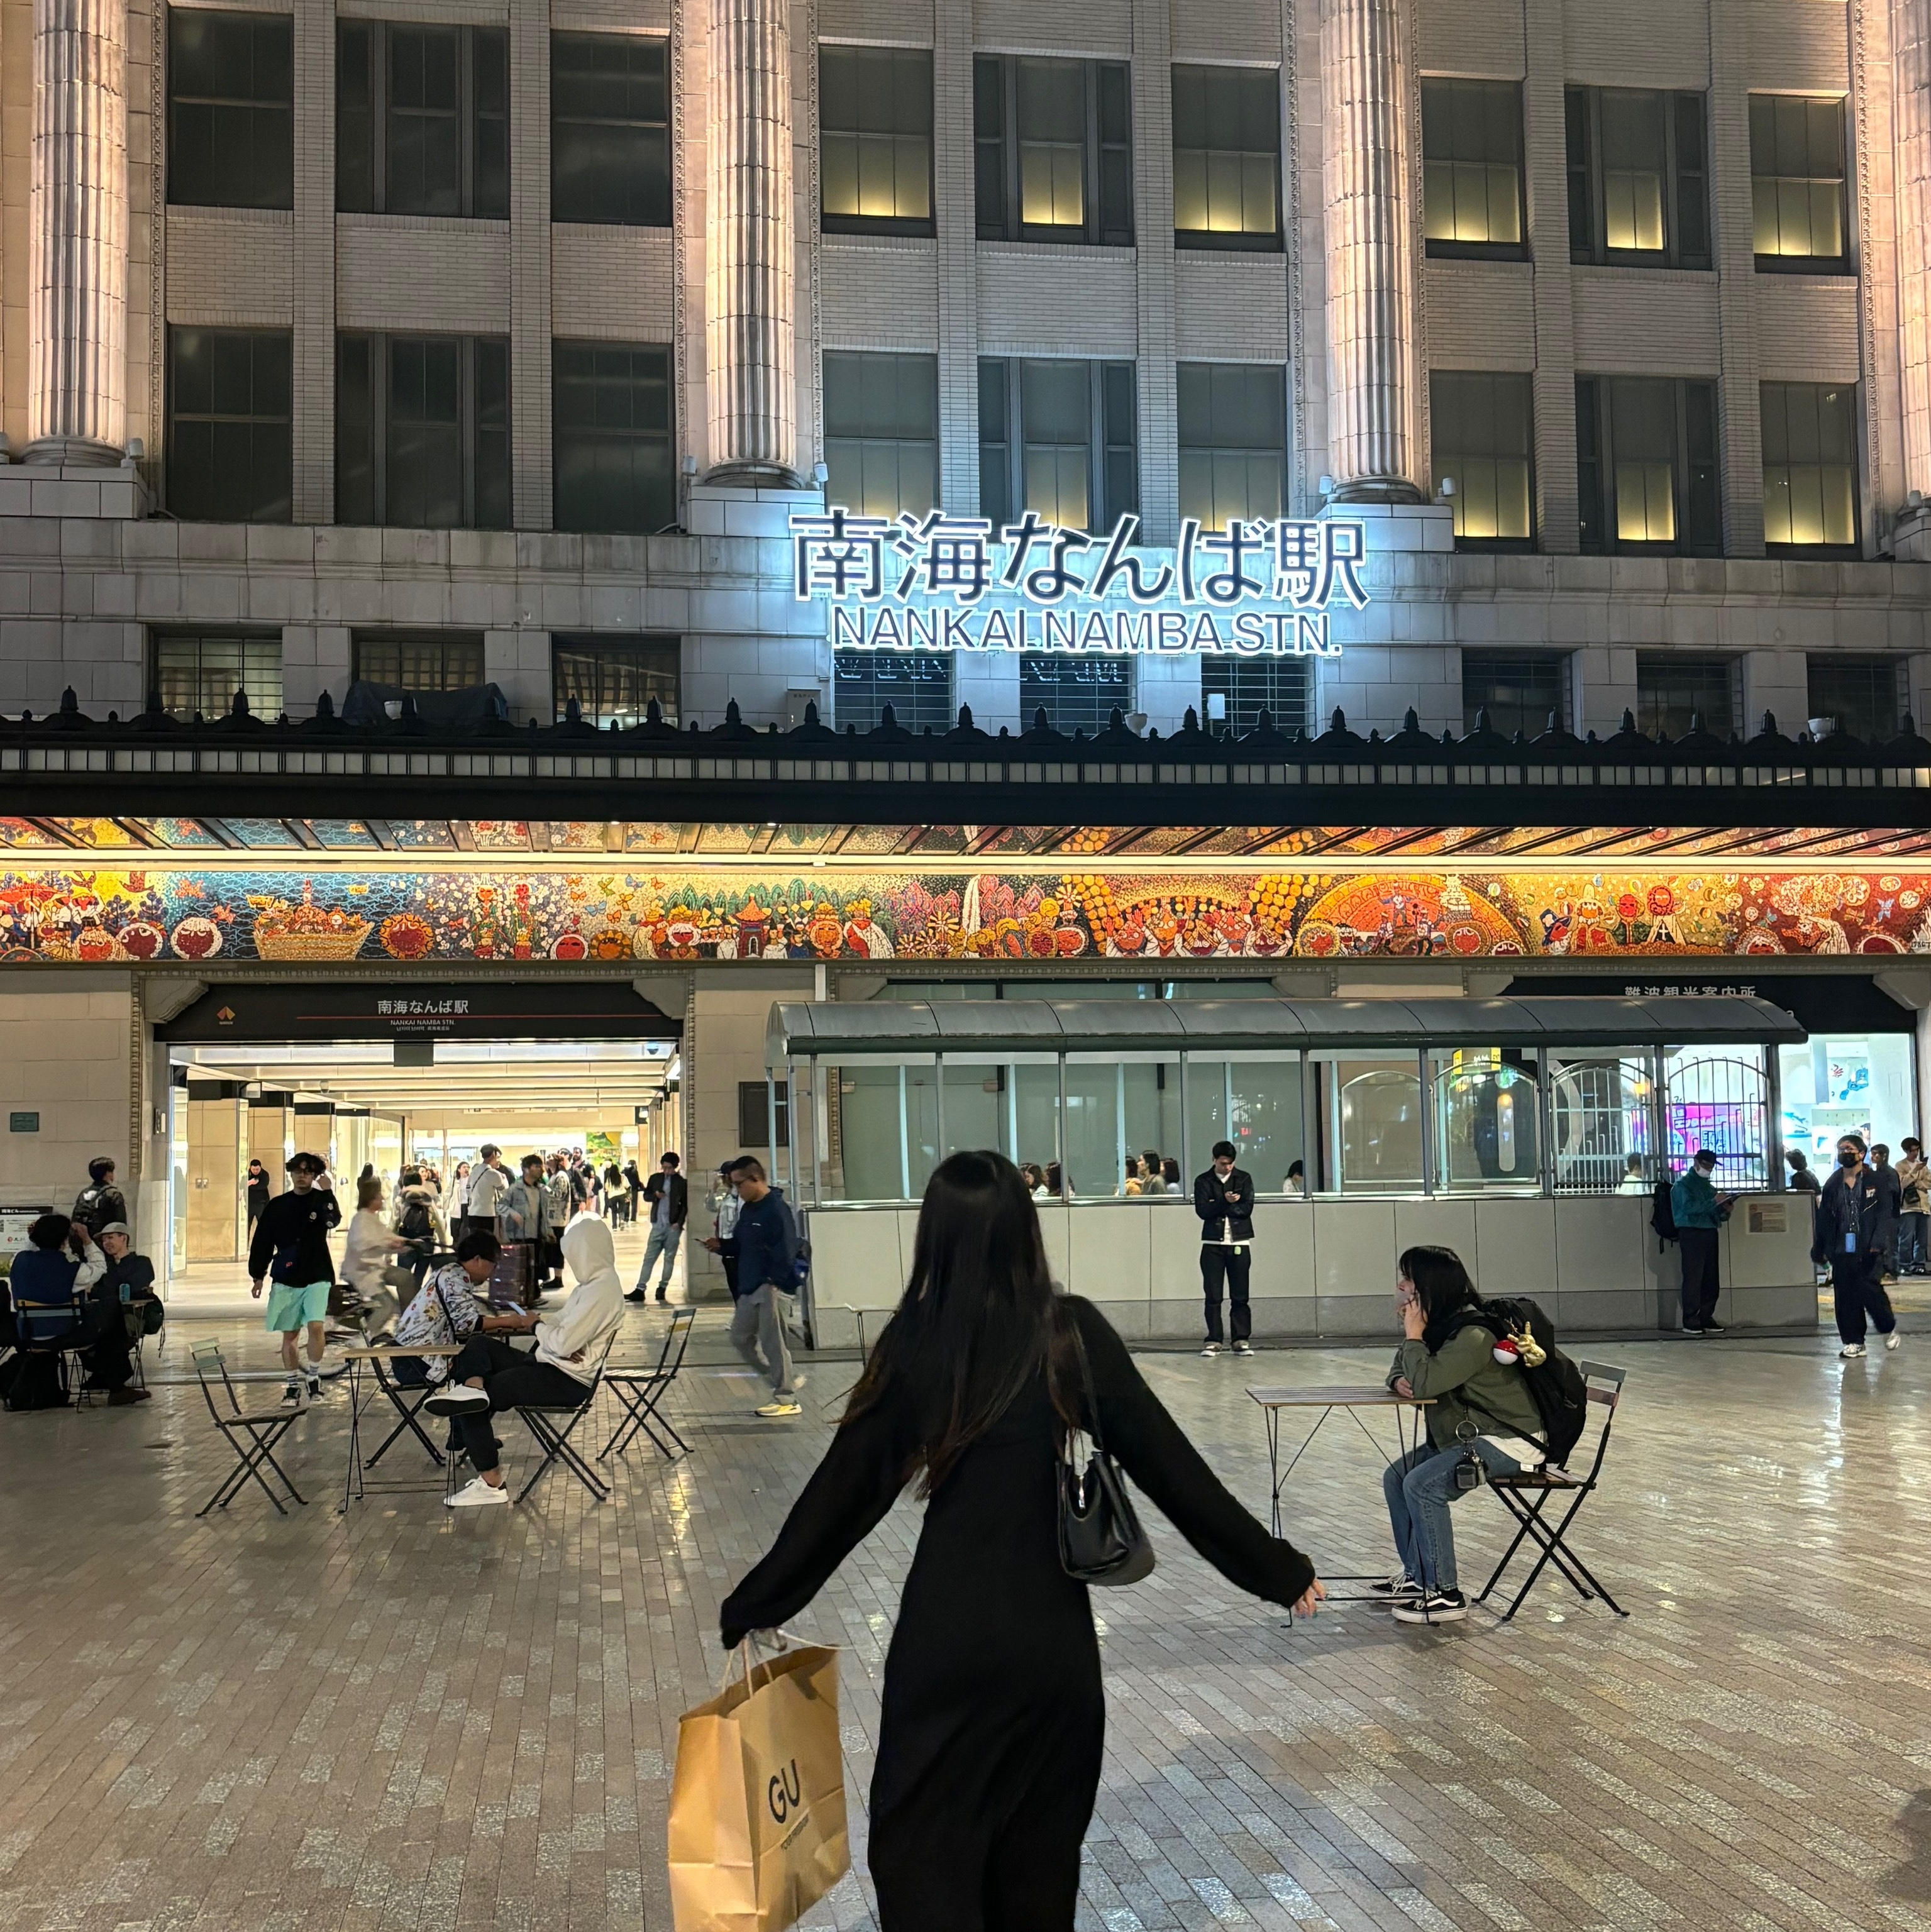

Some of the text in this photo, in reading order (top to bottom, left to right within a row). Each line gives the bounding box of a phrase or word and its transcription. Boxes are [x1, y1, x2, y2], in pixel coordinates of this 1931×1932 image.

[790, 507, 1371, 609] 南海なんば駅
[833, 604, 1342, 655] NANKAI NAMBA STN.
[377, 1000, 468, 1015] 南海なんば駅
[768, 1758, 800, 1824] GU
